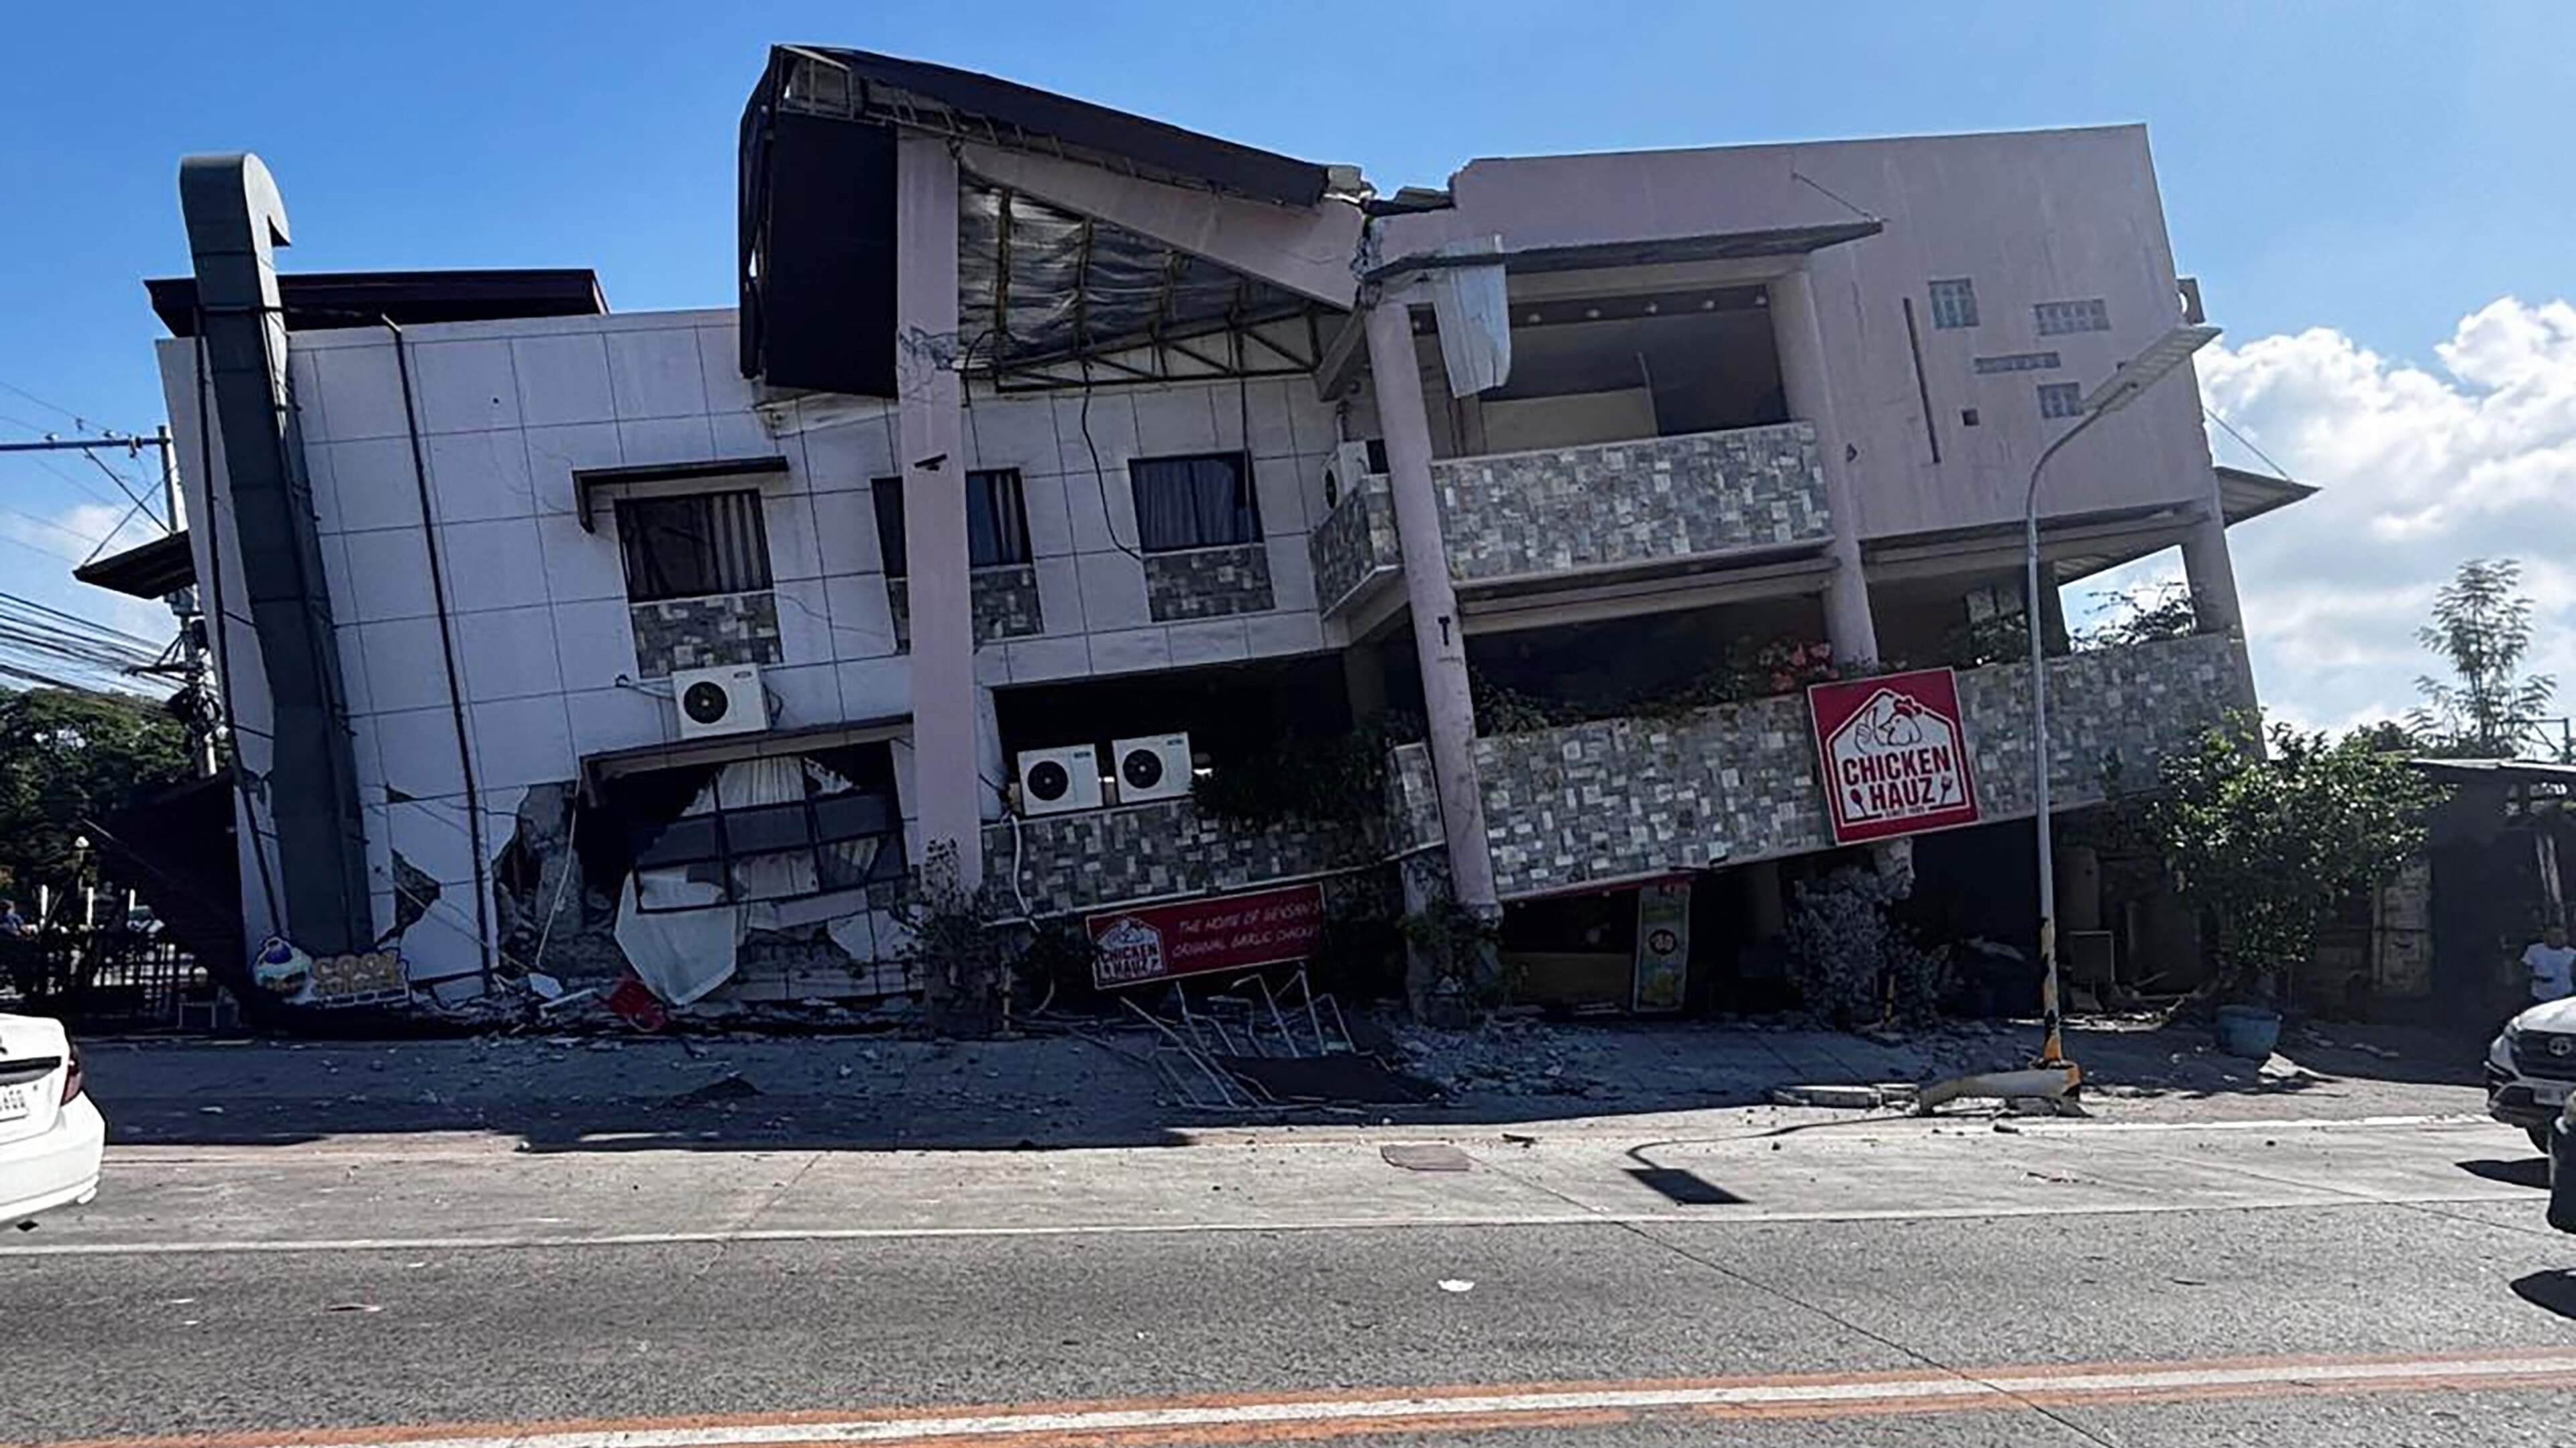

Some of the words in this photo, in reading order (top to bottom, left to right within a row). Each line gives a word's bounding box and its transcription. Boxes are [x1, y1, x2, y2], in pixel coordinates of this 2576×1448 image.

[1842, 745, 1951, 786] CHICKEN
[1868, 777, 1936, 811] HAUZ
[1178, 919, 1202, 933] THE
[1204, 912, 1241, 932] HOME
[1242, 908, 1260, 926] OF
[1099, 942, 1159, 962] CHICKEN
